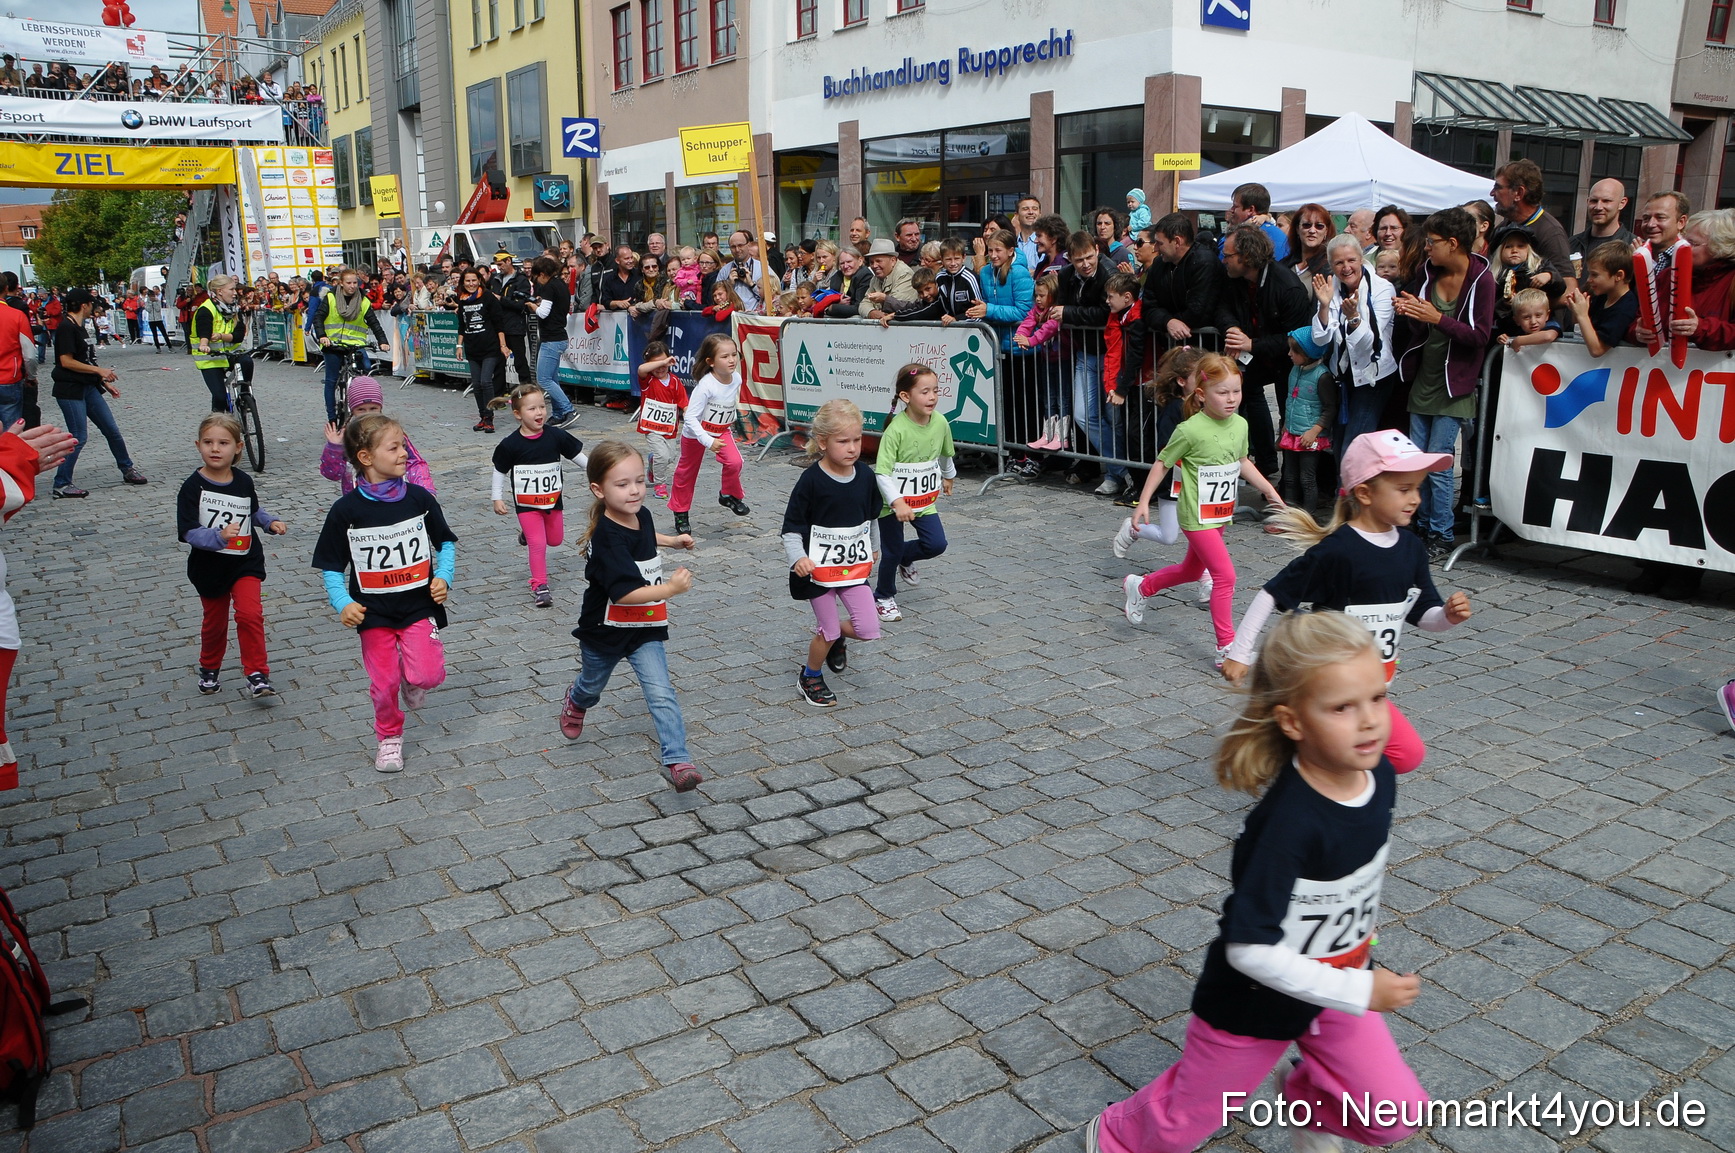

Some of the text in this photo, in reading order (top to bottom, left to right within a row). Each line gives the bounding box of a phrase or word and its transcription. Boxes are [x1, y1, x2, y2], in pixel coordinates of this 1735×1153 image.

[21, 23, 101, 38] LEBENSSPENDER
[42, 37, 86, 49] WERDEN!
[46, 48, 86, 56] www.dkms.de
[823, 28, 1074, 99] Buchhandlung Rupprecht
[149, 115, 252, 130] BMW Laufsport
[685, 138, 747, 152] Schnupper-
[708, 151, 728, 163] lauf
[1162, 158, 1193, 167] Infopoint
[54, 152, 125, 176] ZIEL
[373, 186, 398, 196] Jugend
[381, 195, 394, 203] lauf
[834, 341, 883, 353] Gebäudereinigung
[926, 344, 947, 356] UNS
[835, 353, 886, 365] Hausmeisterdienste
[836, 368, 865, 378] Mietservice
[840, 381, 891, 394] Event-Leit-Systeme
[646, 406, 674, 424] 7052
[520, 474, 558, 493] 7192
[897, 472, 937, 495] 7190
[1206, 477, 1237, 503] 721
[202, 496, 226, 507] PARTL
[534, 496, 550, 505] Anja
[905, 496, 931, 508] Hannah
[350, 526, 415, 543] PARTL Neumarkt
[812, 531, 837, 541] PARTL
[360, 537, 423, 570] 7212
[818, 539, 868, 565] 7393
[383, 572, 412, 586] Alina
[1355, 614, 1383, 623] RTL
